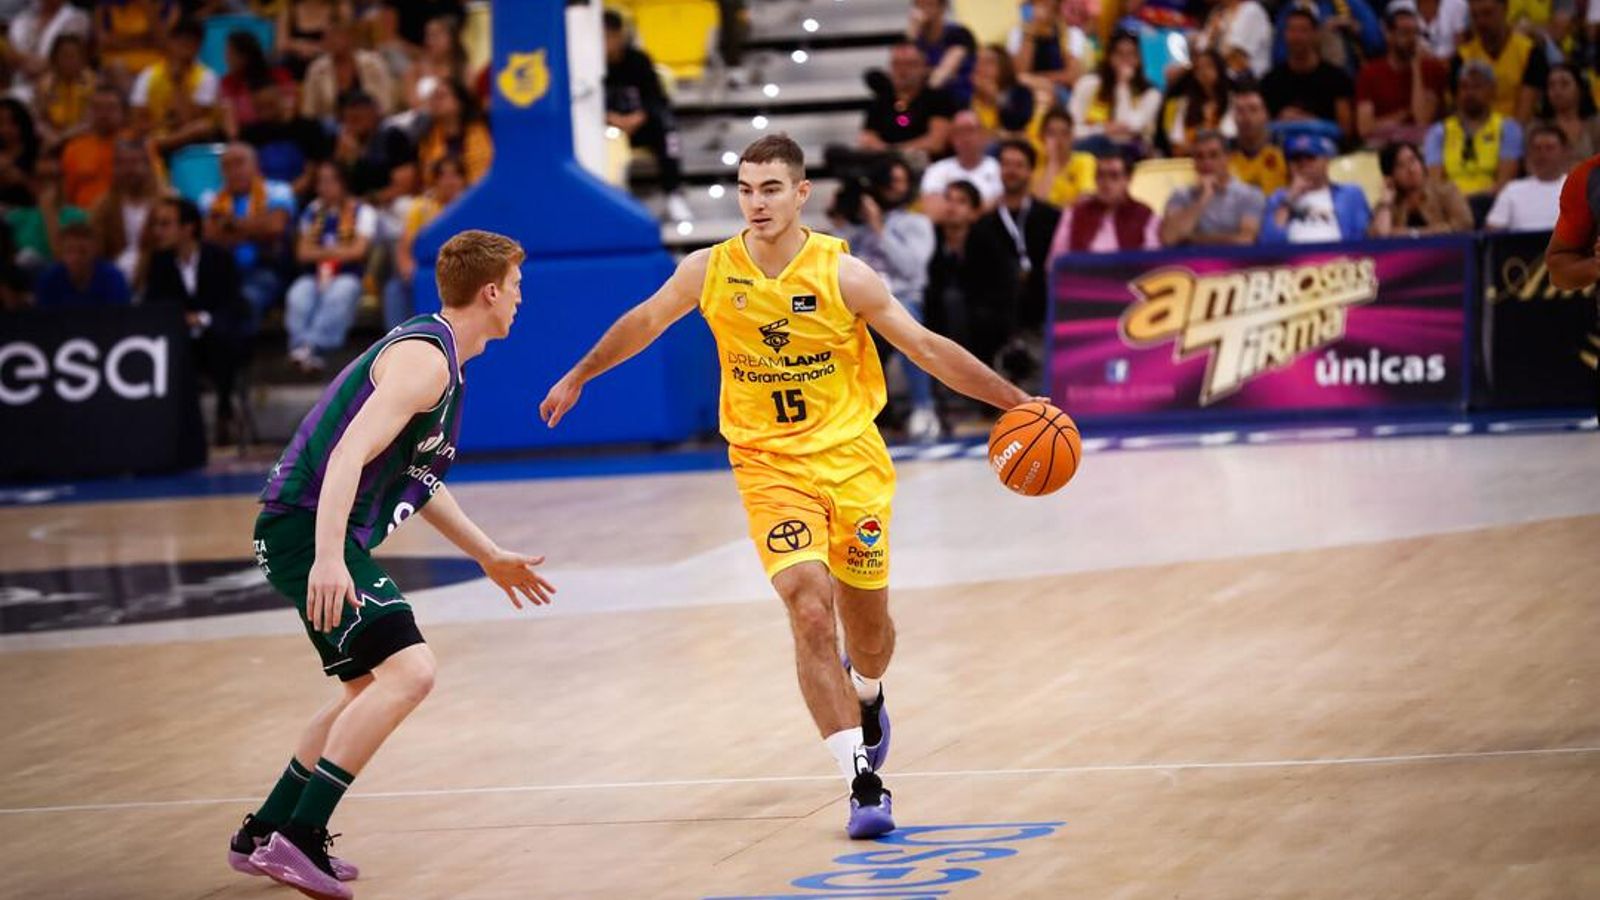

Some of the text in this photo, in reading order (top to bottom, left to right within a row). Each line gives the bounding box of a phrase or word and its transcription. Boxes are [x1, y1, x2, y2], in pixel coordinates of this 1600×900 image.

[728, 351, 832, 369] DREAMLAND
[1315, 348, 1446, 387] únicas
[747, 364, 836, 384] GranCanaria
[771, 389, 807, 424] 15
